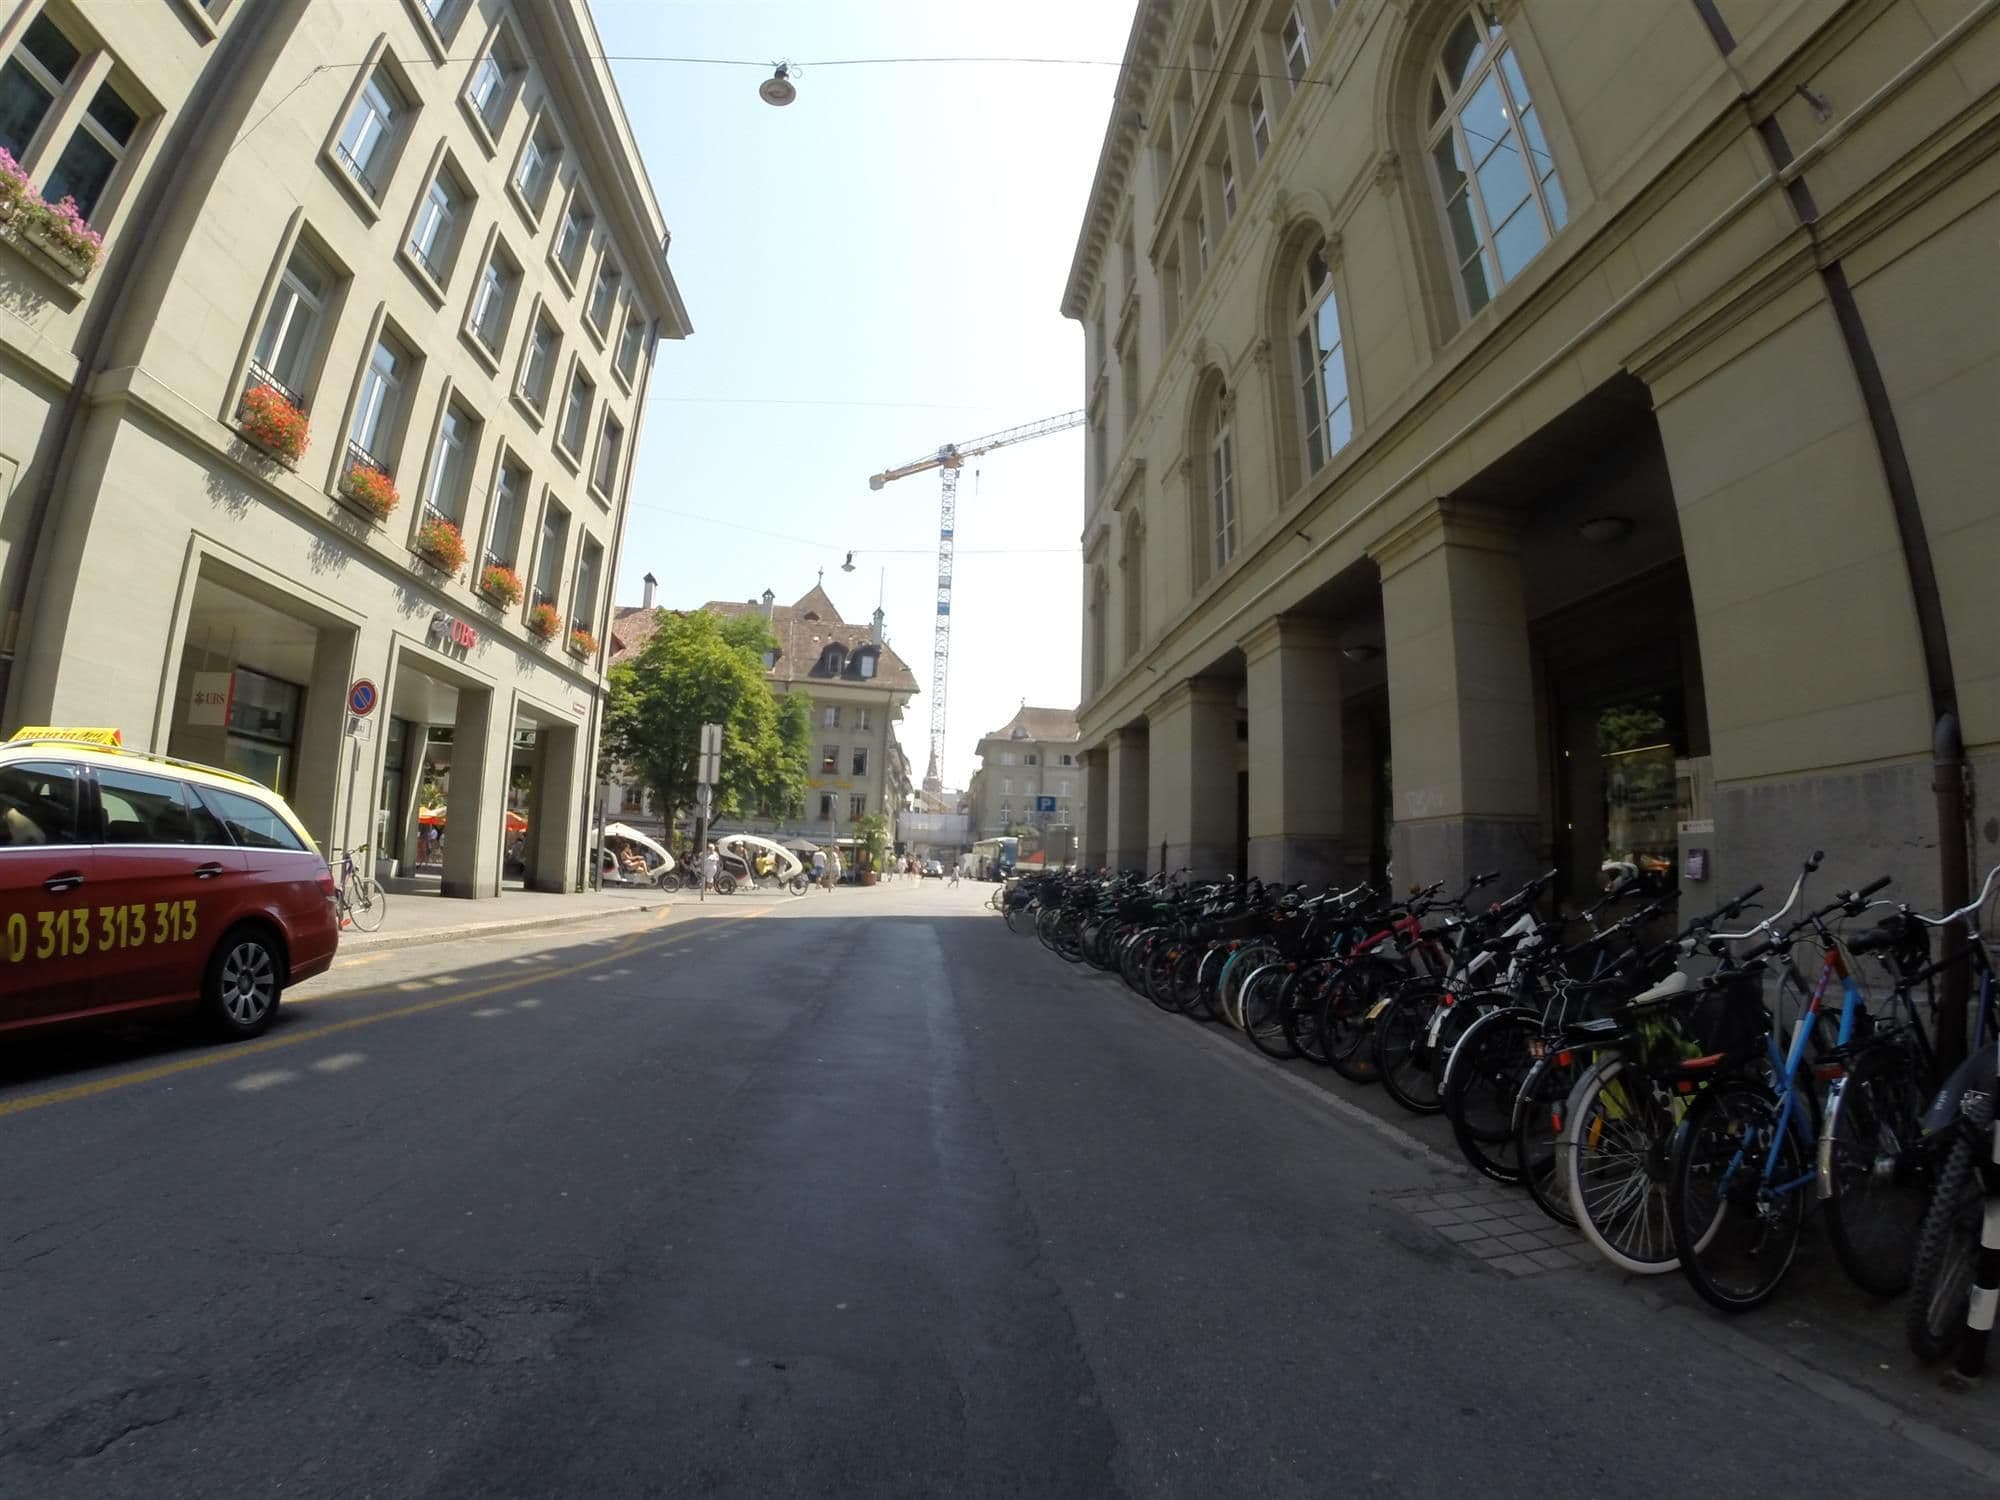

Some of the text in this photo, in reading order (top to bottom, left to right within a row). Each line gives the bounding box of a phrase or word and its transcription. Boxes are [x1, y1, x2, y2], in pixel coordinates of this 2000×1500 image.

[453, 618, 477, 648] UBS
[207, 692, 225, 705] UBS
[7, 900, 197, 962] 0 313 313 313
